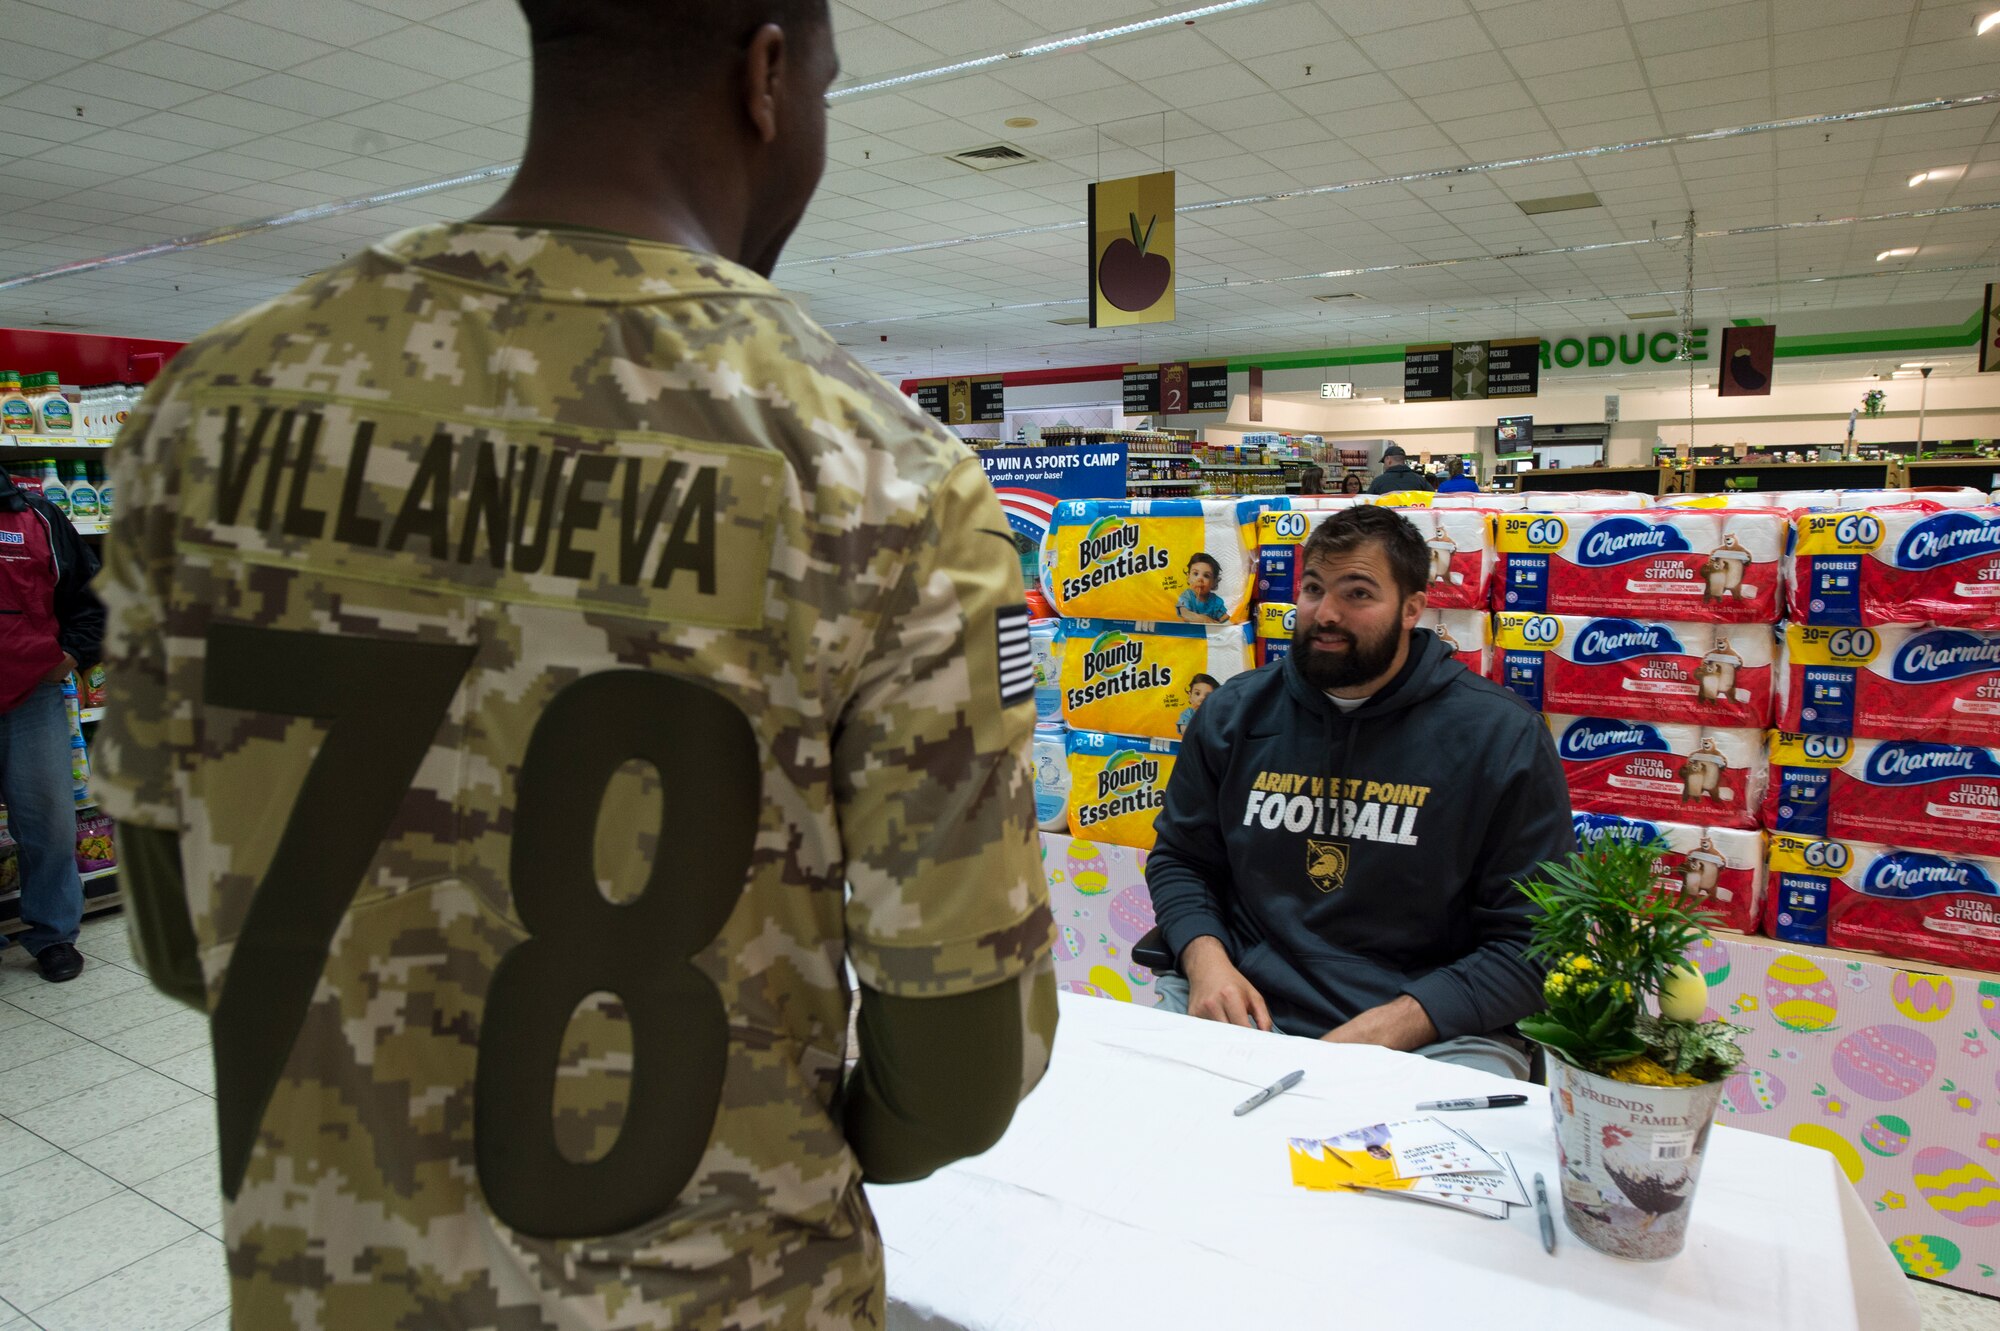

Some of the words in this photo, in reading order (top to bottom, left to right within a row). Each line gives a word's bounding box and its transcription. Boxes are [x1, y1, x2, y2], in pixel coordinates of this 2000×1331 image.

[1490, 350, 1508, 358] PICKLES
[1539, 328, 1709, 369] RODUCE
[1463, 372, 1474, 395] 1
[1502, 373, 1529, 381] SHORTENING
[1322, 384, 1347, 397] EXIT
[1488, 386, 1507, 394] GELATIN
[1507, 385, 1531, 393] DESSERTS
[1167, 389, 1181, 411] 2
[955, 402, 966, 420] 3
[980, 458, 994, 471] LP
[997, 457, 1020, 470] WIN
[1023, 456, 1032, 469] A
[1035, 454, 1080, 468] SPORTS
[1083, 452, 1120, 467] CAMP
[991, 472, 1013, 483] youth
[1014, 473, 1024, 481] on
[1025, 473, 1043, 482] your
[1043, 471, 1063, 480] base!
[216, 405, 718, 595] VILLANUEVA
[1069, 501, 1086, 517] 18
[1276, 513, 1306, 537] 60
[1527, 518, 1565, 545] 60
[1835, 515, 1880, 545] 60
[0, 532, 18, 543] USO
[1079, 523, 1139, 571] Bounty
[1586, 525, 1666, 558] Charmin
[1510, 559, 1547, 567] DOUBLES
[1654, 560, 1685, 569] ULTRA
[1814, 562, 1857, 571] DOUBLES
[1062, 546, 1169, 602] Essentials
[1645, 568, 1694, 580] STRONG
[1283, 609, 1297, 631] 6
[1523, 616, 1558, 642] 60
[1581, 625, 1660, 656] Charmin
[1828, 627, 1875, 658] 60
[1084, 640, 1143, 682] Bounty
[1506, 656, 1542, 665] DOUBLES
[1649, 661, 1678, 670] ULTRA
[1640, 668, 1688, 681] STRONG
[1807, 672, 1852, 682] DOUBLES
[1067, 663, 1171, 711] Essentials
[1087, 733, 1104, 748] 18
[1568, 725, 1645, 752] Charmin
[1803, 735, 1848, 759] 60
[1634, 758, 1664, 768] ULTRA
[1876, 746, 1975, 777] Charmin
[1098, 759, 1158, 800] Bounty
[1625, 765, 1672, 779] STRONG
[1785, 773, 1827, 783] DOUBLES
[1252, 770, 1309, 794] ARMY
[1311, 776, 1362, 800] WEST
[1363, 781, 1431, 807] POINT
[1960, 784, 1998, 795] ULTRA
[1079, 785, 1166, 827] Essentia
[1948, 792, 2000, 807] STRON
[1243, 790, 1419, 846] FOOTBALL
[1803, 841, 1848, 869] 60
[1783, 879, 1827, 892] DOUBLES
[1874, 861, 1969, 890] Charmin
[1956, 899, 1993, 912] ULTRA
[200, 622, 763, 1241] 78
[1580, 1086, 1655, 1113] FRIENDS
[1630, 1114, 1692, 1126] FAMILY
[1432, 1175, 1498, 1189] ALEJANDRO
